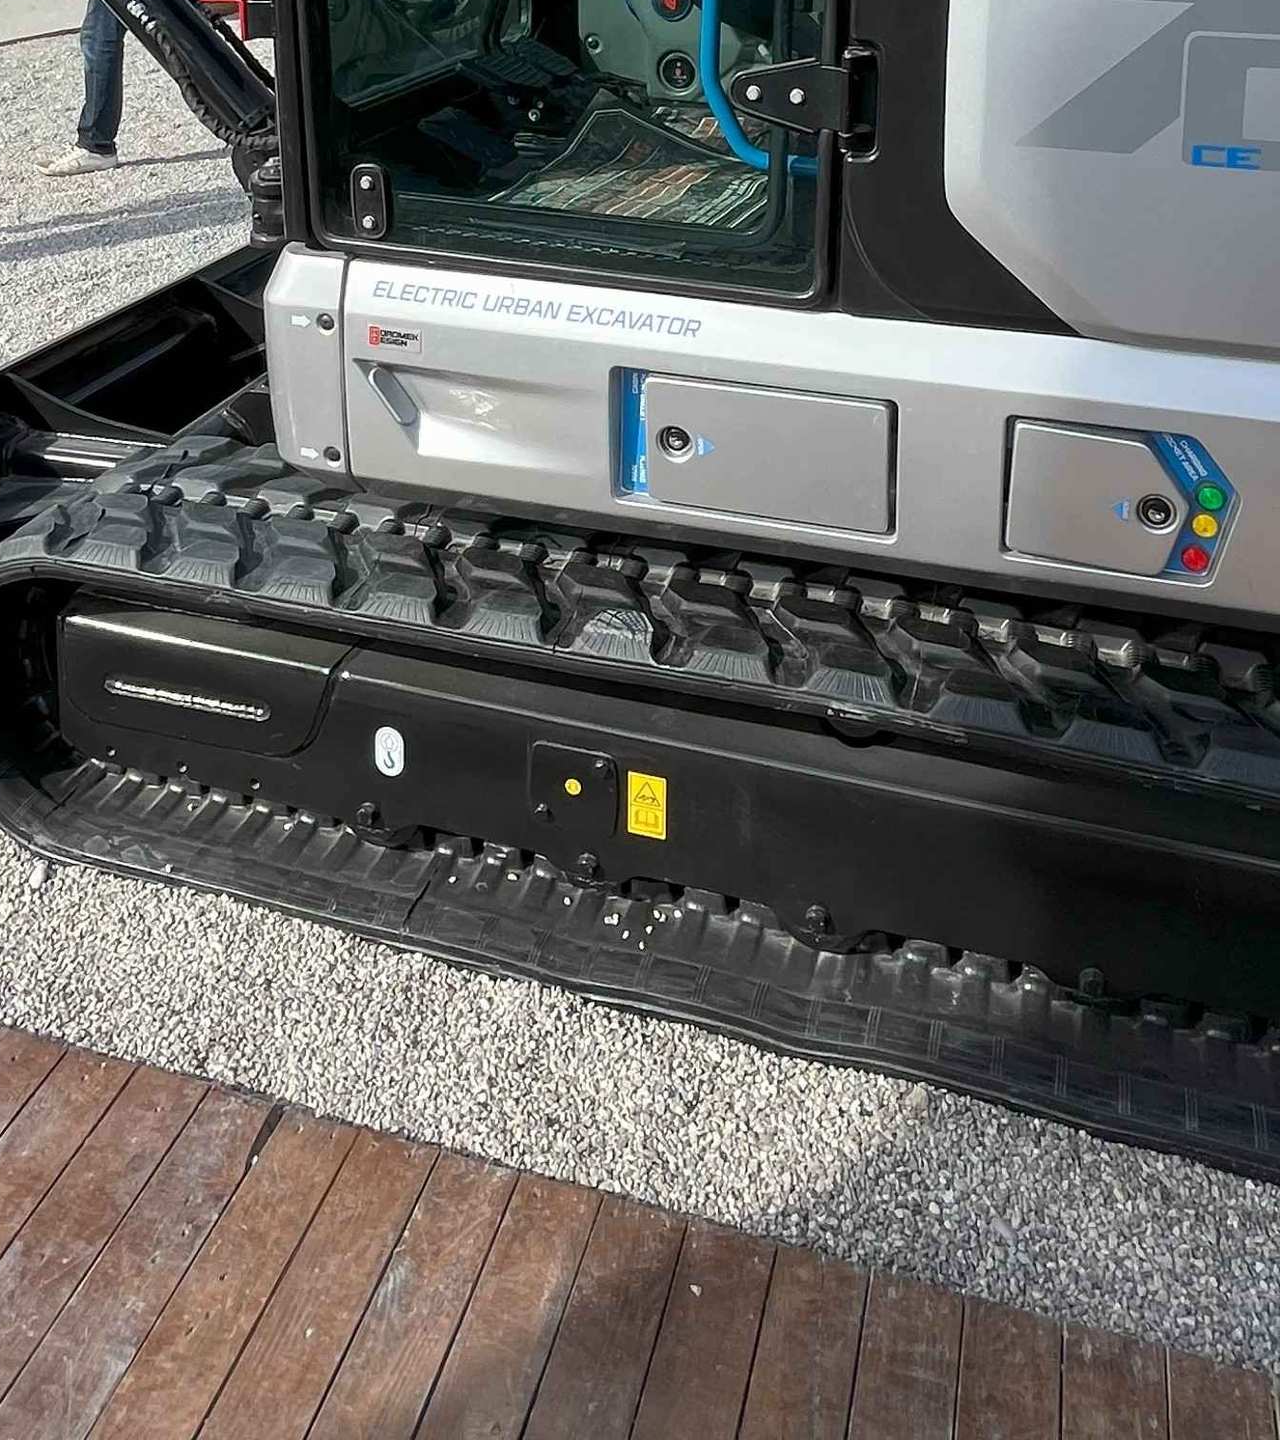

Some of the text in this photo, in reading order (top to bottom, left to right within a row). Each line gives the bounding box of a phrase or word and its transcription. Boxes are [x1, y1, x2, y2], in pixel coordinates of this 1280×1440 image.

[1191, 144, 1262, 171] CE
[372, 280, 702, 338] ELECTRIC URBAN EXCAVATOR
